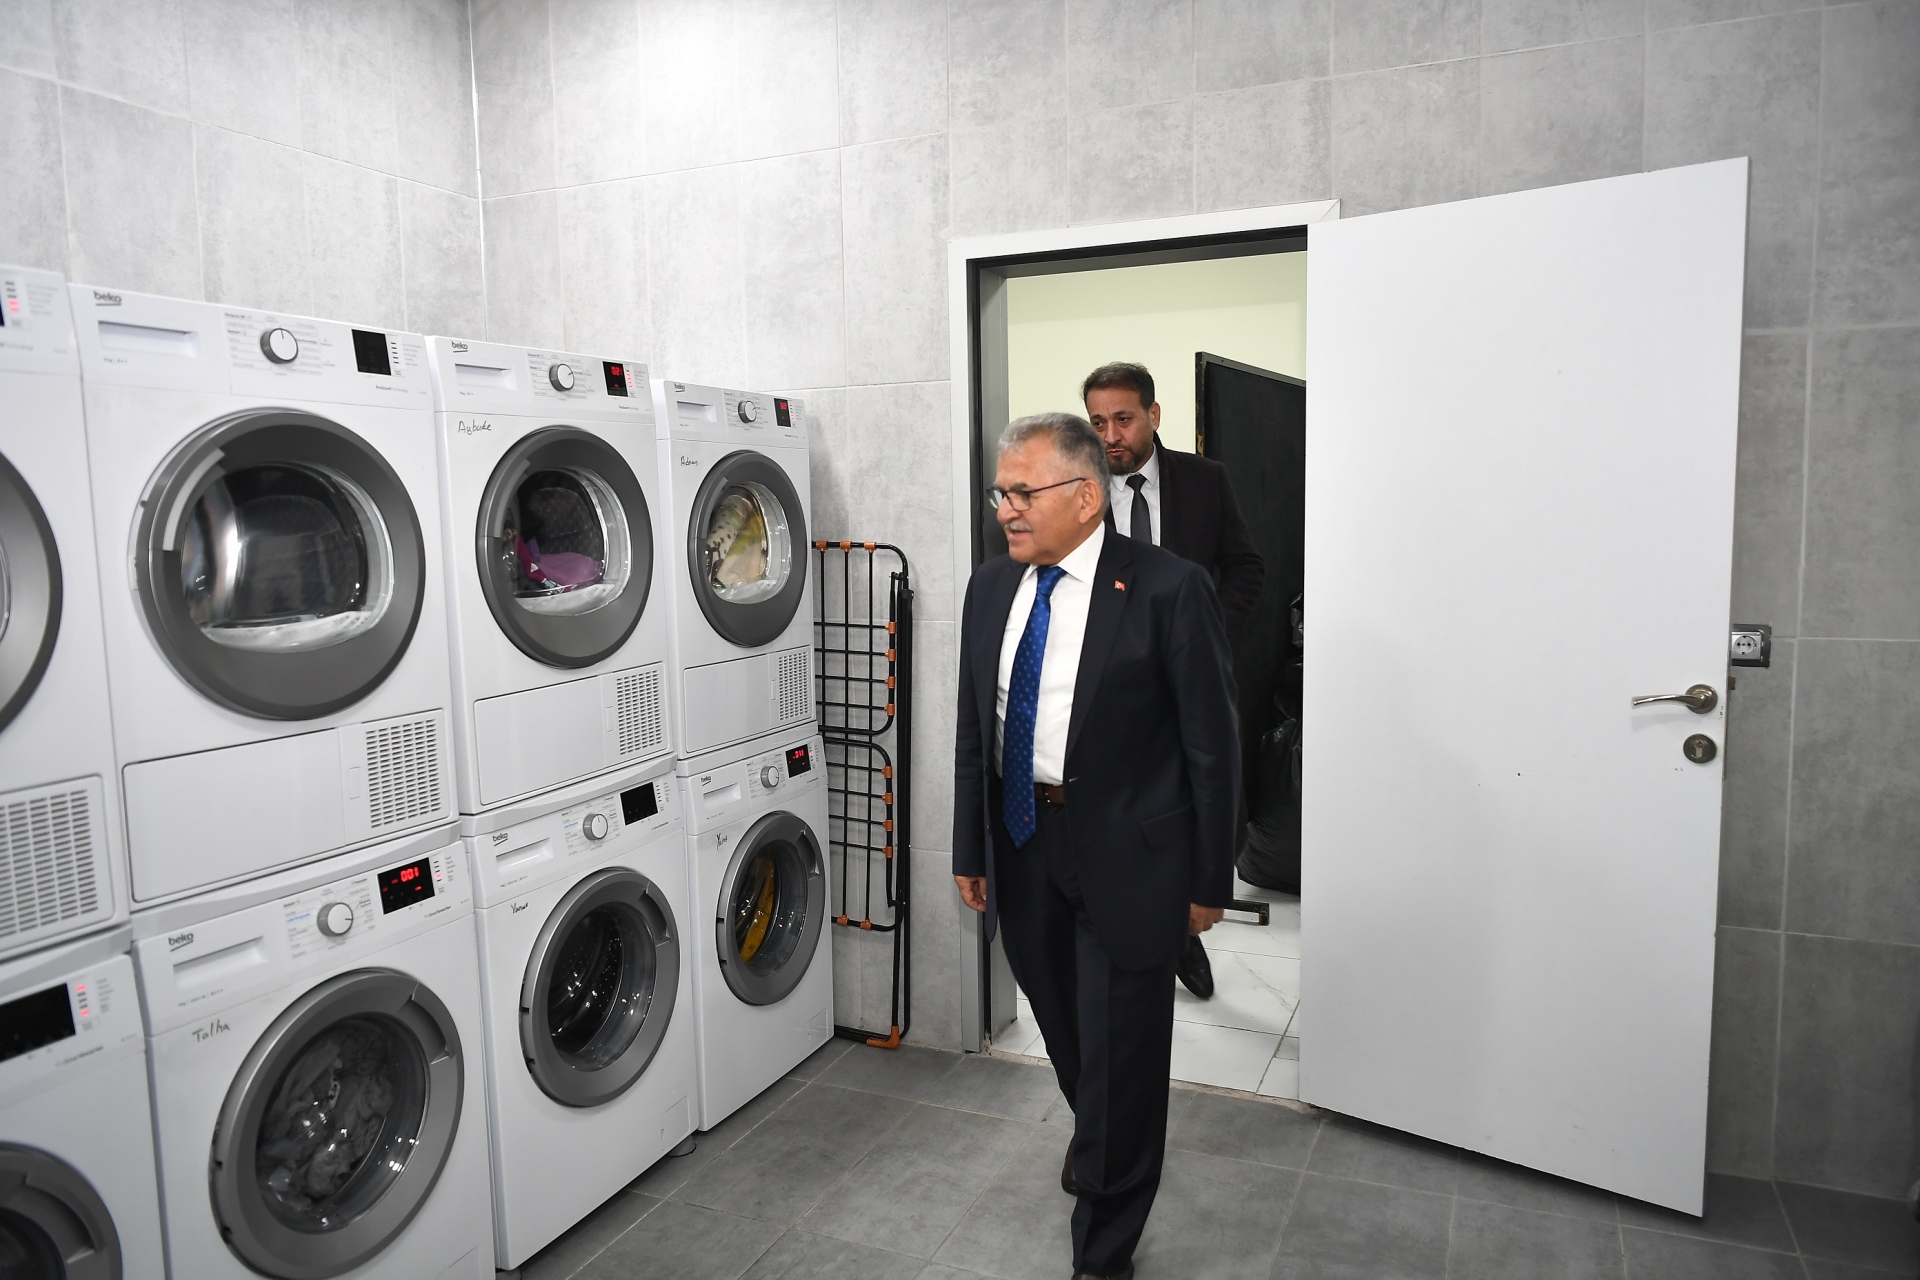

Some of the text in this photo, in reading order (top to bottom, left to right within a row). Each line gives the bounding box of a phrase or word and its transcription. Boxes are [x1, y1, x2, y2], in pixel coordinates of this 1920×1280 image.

[93, 291, 122, 303] beko
[451, 341, 469, 350] beko
[700, 775, 712, 784] beko
[492, 832, 509, 843] beko
[400, 867, 419, 882] 001
[168, 933, 194, 947] beko
[191, 1019, 230, 1043] Talha
